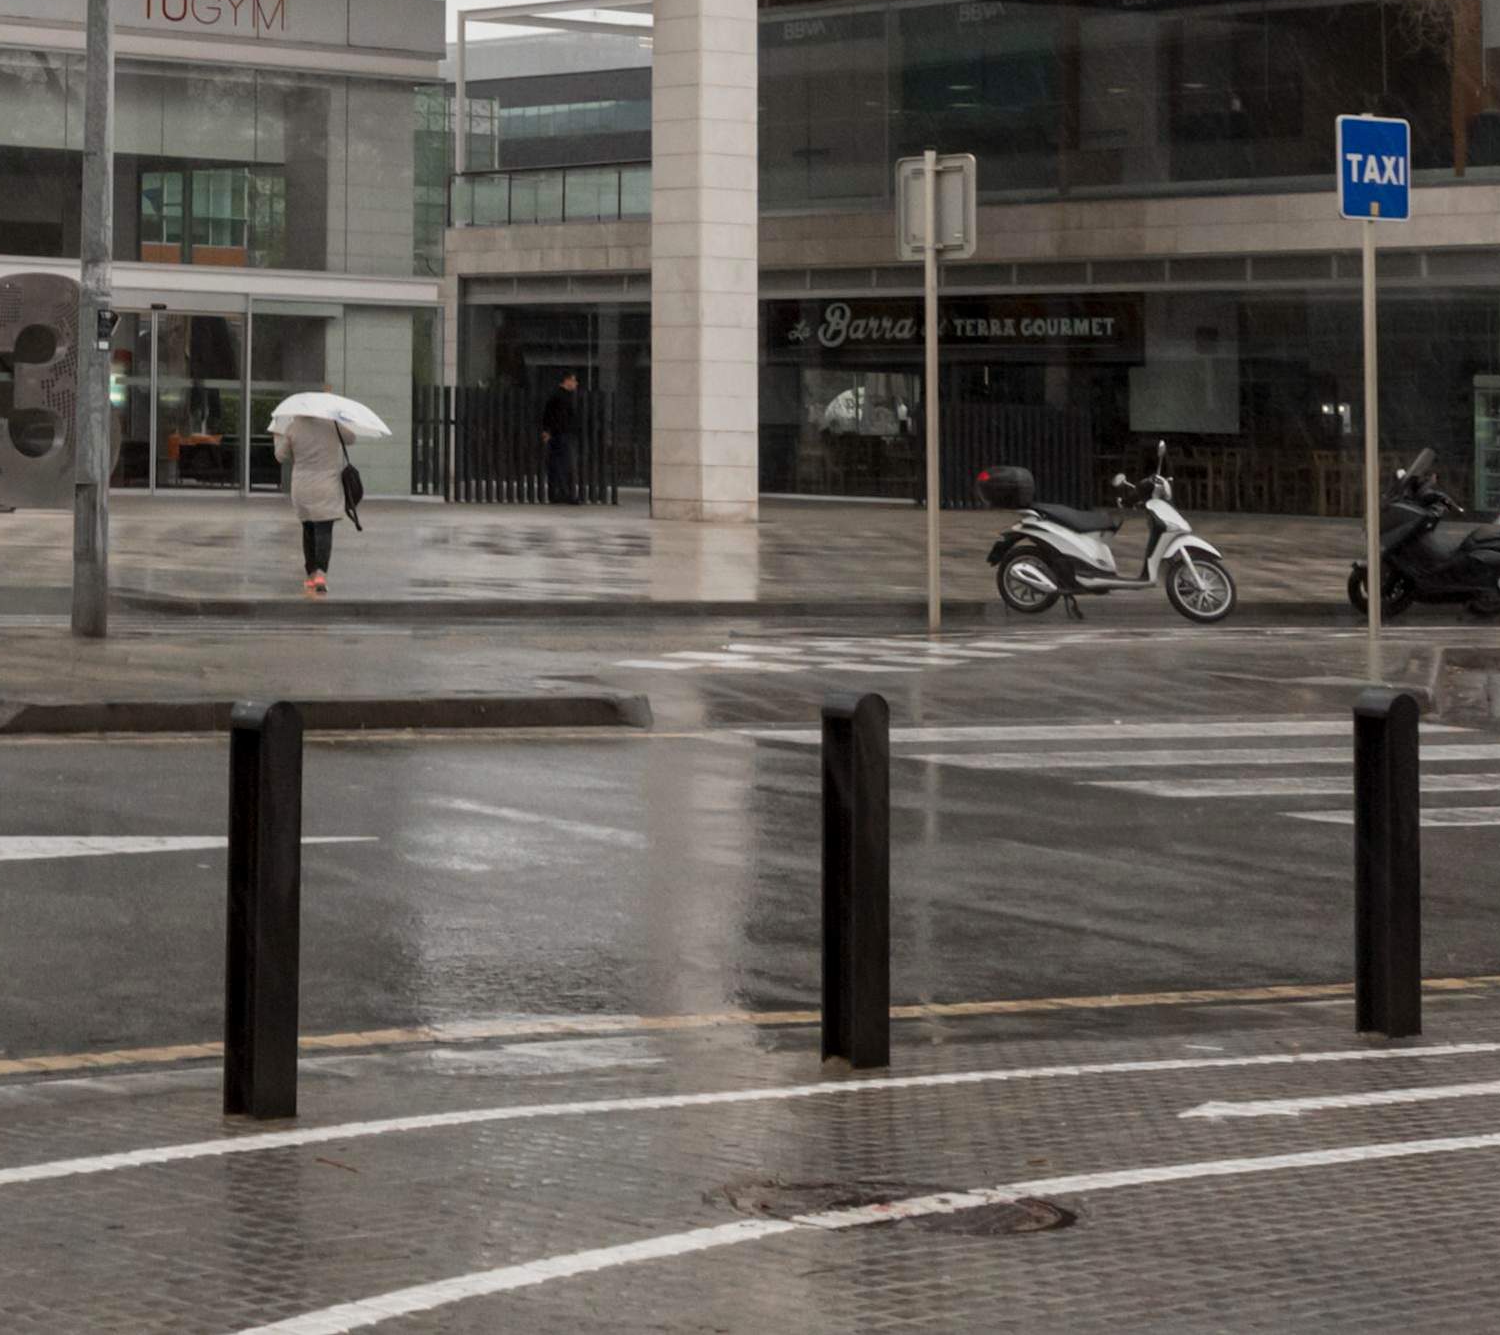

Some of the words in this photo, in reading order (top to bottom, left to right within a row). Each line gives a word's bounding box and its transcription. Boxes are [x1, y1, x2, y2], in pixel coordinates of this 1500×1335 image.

[958, 1, 1005, 26] BBVA
[784, 19, 826, 42] BBVA
[1345, 153, 1405, 186] TAXI
[818, 302, 917, 348] Barra
[954, 319, 1016, 337] TERRA
[1020, 317, 1115, 337] GOURMET
